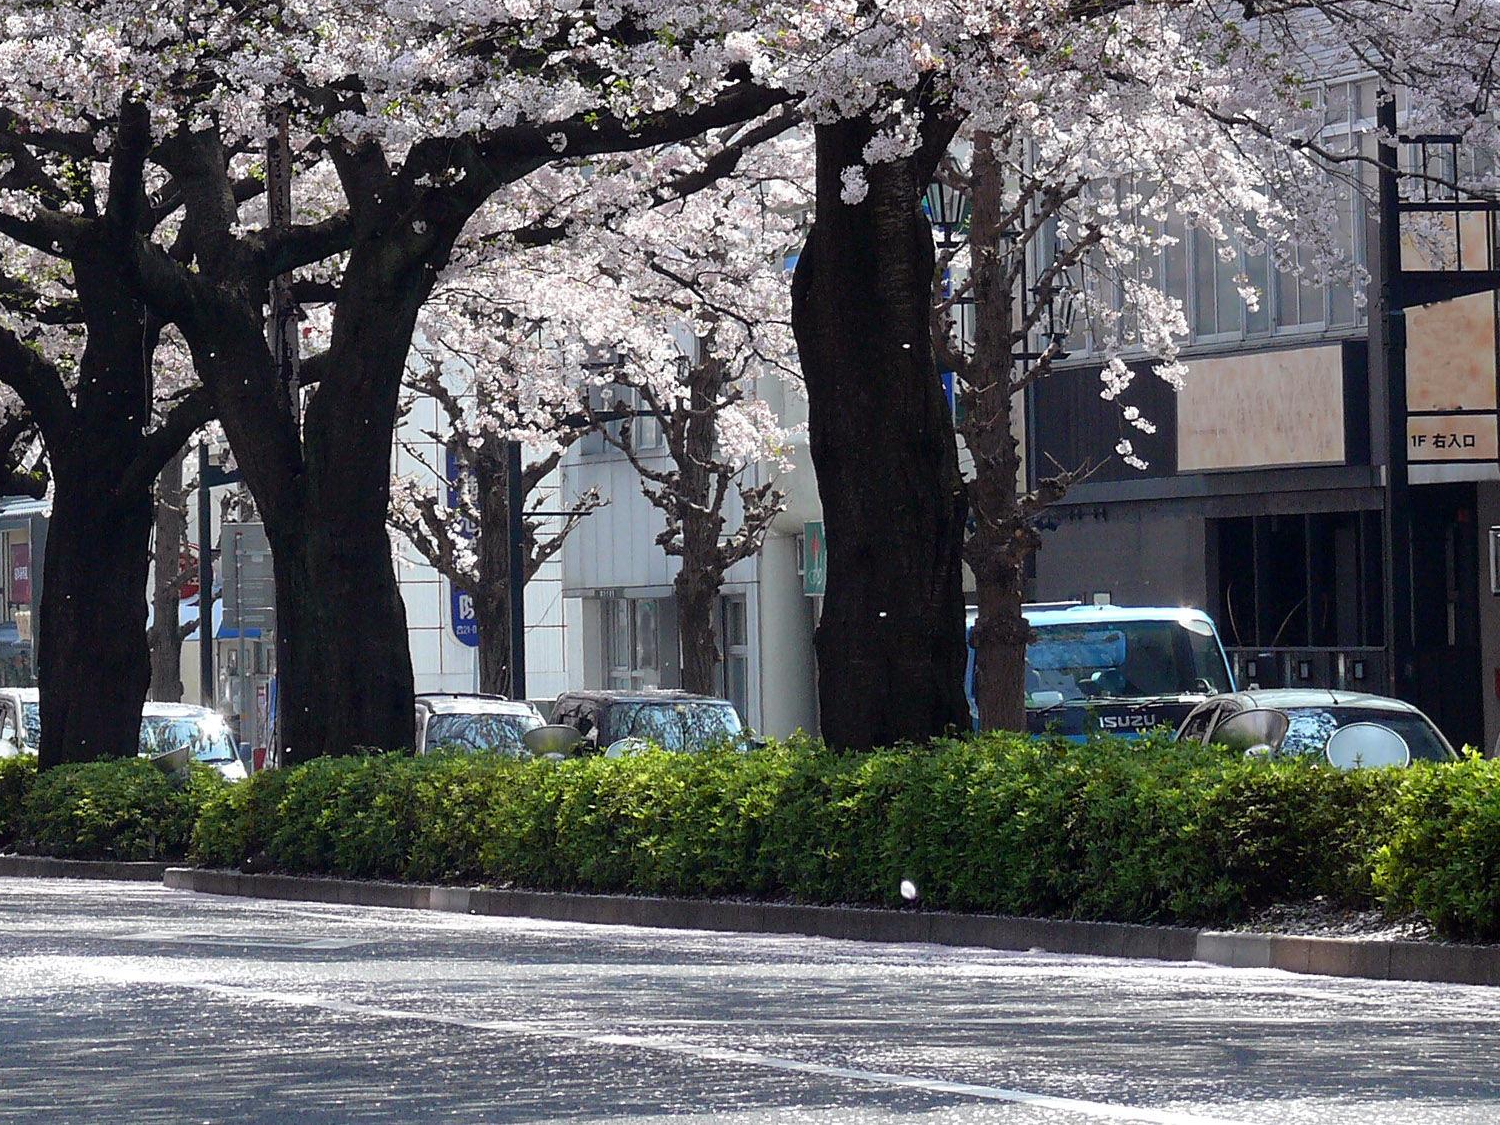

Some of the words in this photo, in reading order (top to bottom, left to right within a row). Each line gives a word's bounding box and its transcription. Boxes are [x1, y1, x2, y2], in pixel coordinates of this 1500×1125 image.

[1411, 434, 1427, 448] 1F
[1432, 433, 1476, 449] 右入口
[1099, 714, 1156, 729] ISUZU
